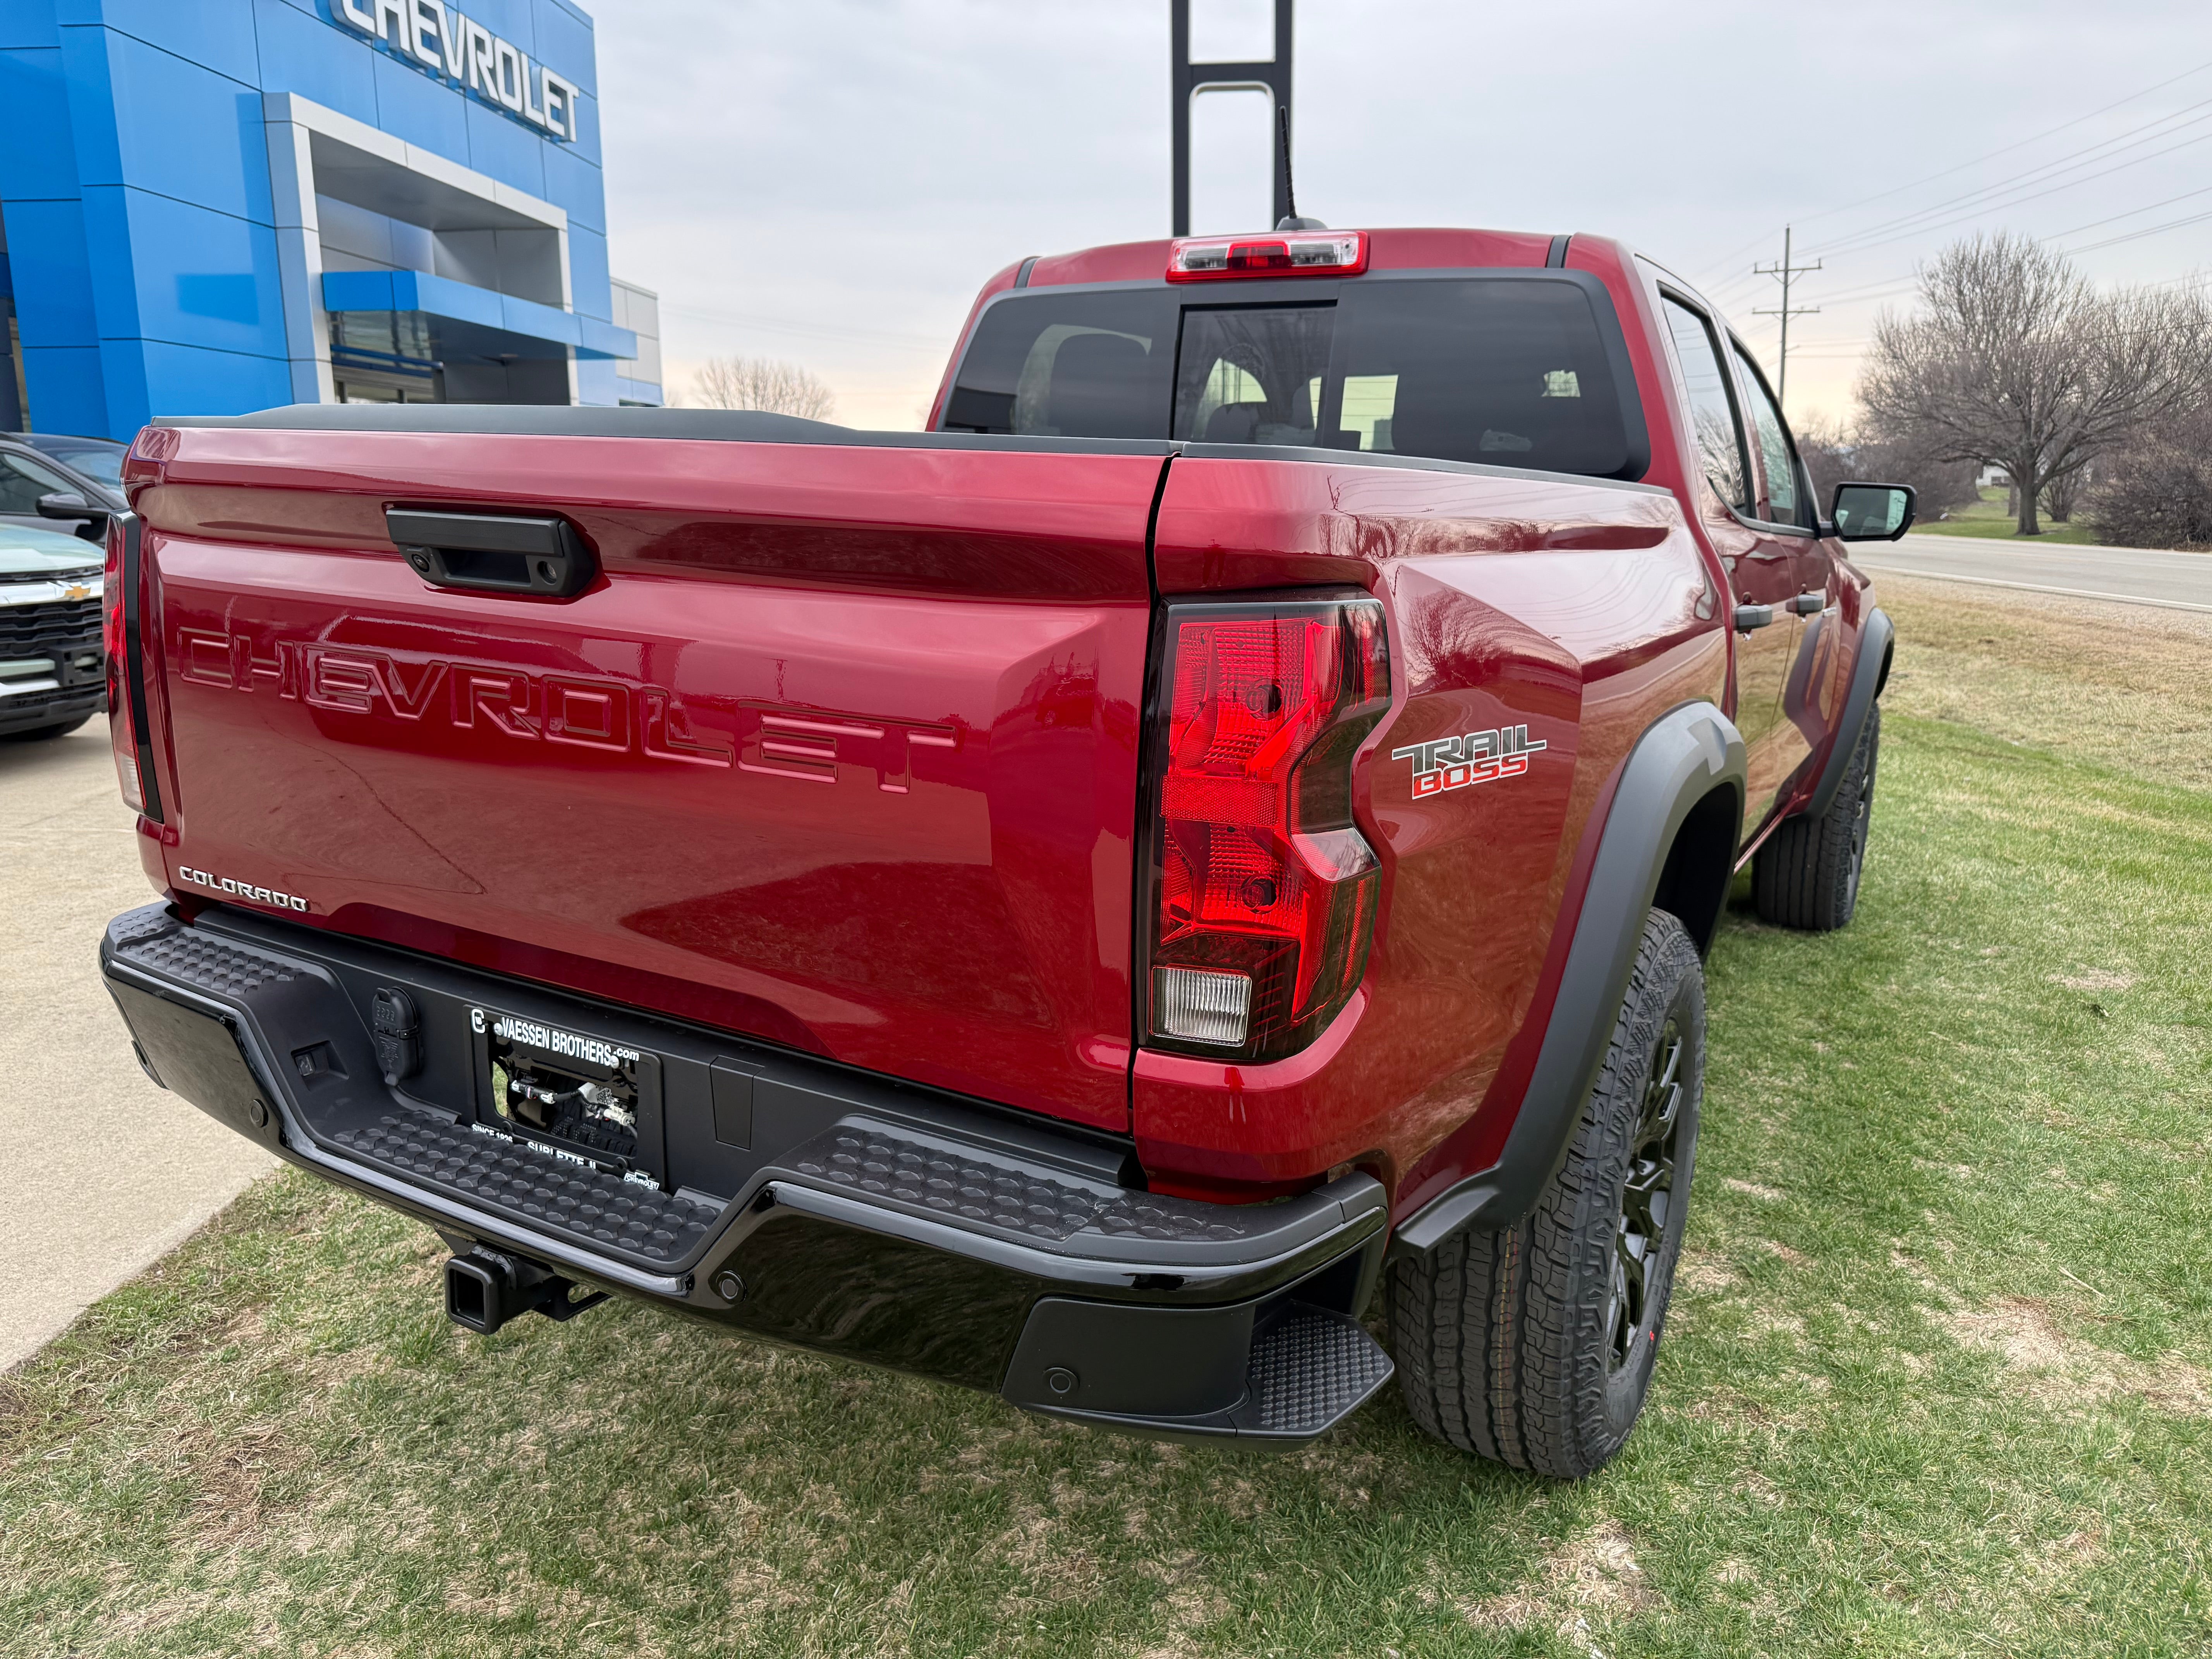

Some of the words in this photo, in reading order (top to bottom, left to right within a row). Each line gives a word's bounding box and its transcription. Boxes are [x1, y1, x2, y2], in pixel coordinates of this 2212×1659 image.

[177, 626, 957, 795] CHEVROLET
[1392, 724, 1547, 775] TRAIL
[1412, 752, 1528, 800] BOSS
[179, 866, 309, 913] COLORADO
[501, 1017, 550, 1049] VAESSEN
[627, 1175, 657, 1190] CHEVROLET
